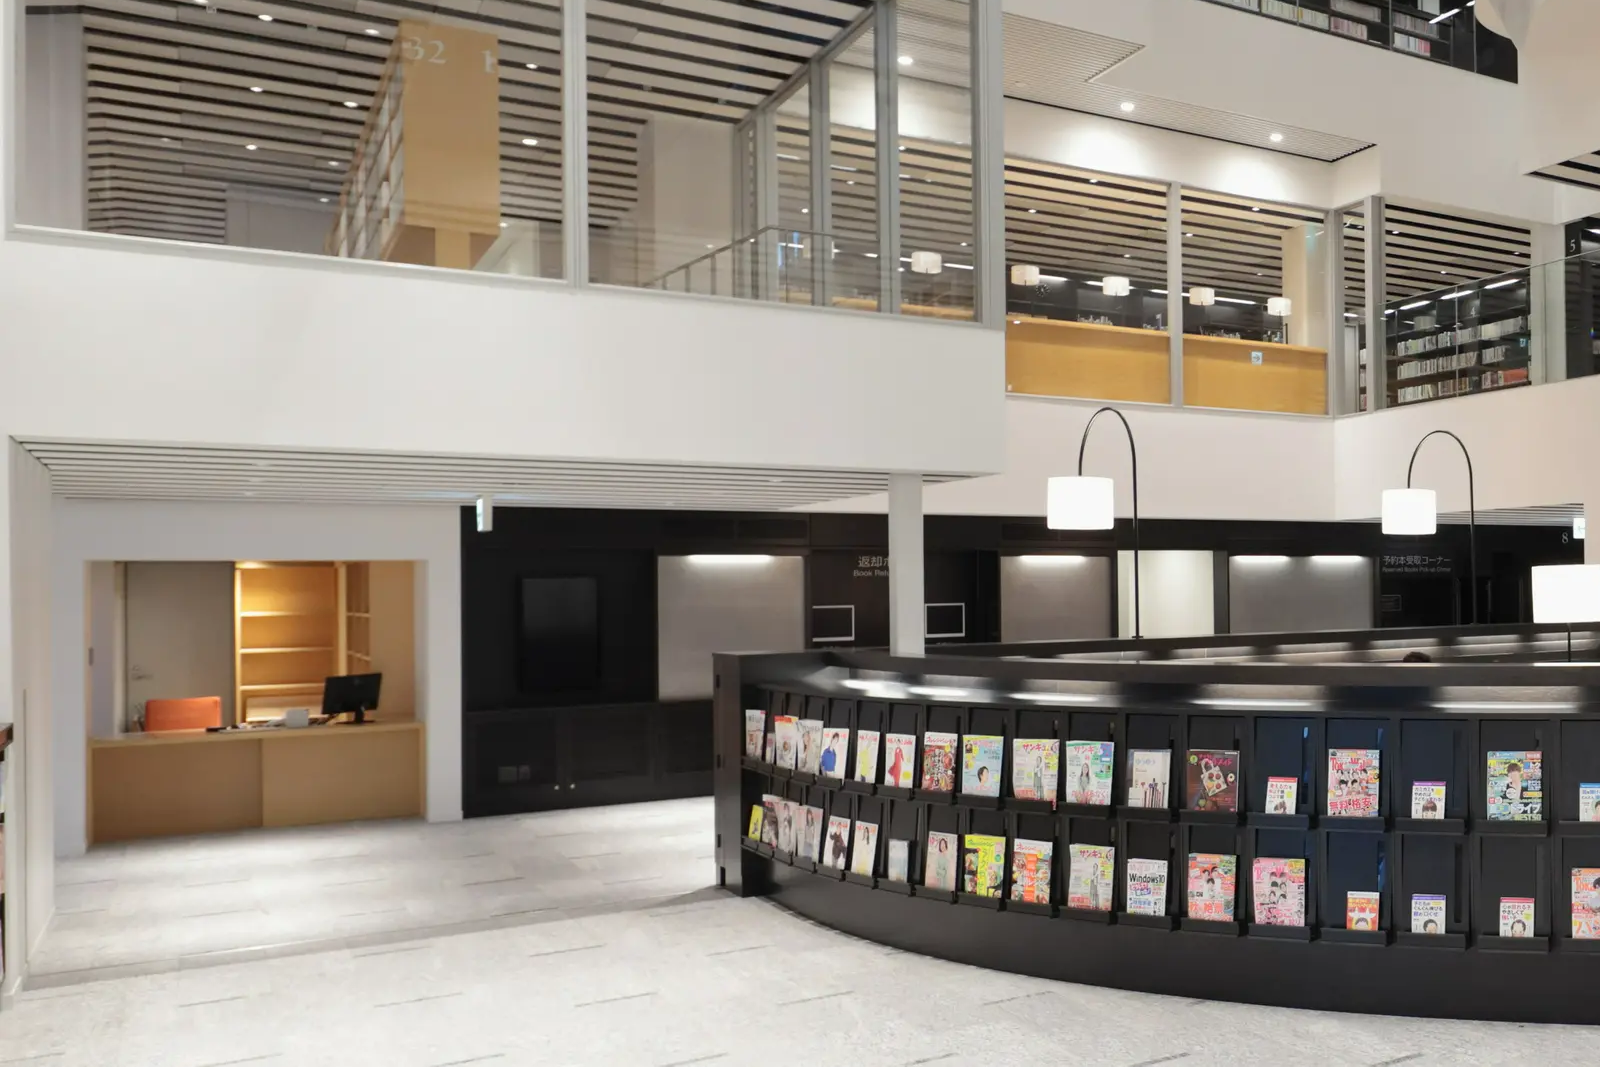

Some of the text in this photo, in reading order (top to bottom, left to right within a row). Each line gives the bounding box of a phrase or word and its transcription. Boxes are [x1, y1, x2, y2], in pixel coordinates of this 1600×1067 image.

[1569, 238, 1576, 253] 5
[1561, 531, 1569, 544] 8
[853, 569, 873, 577] Book
